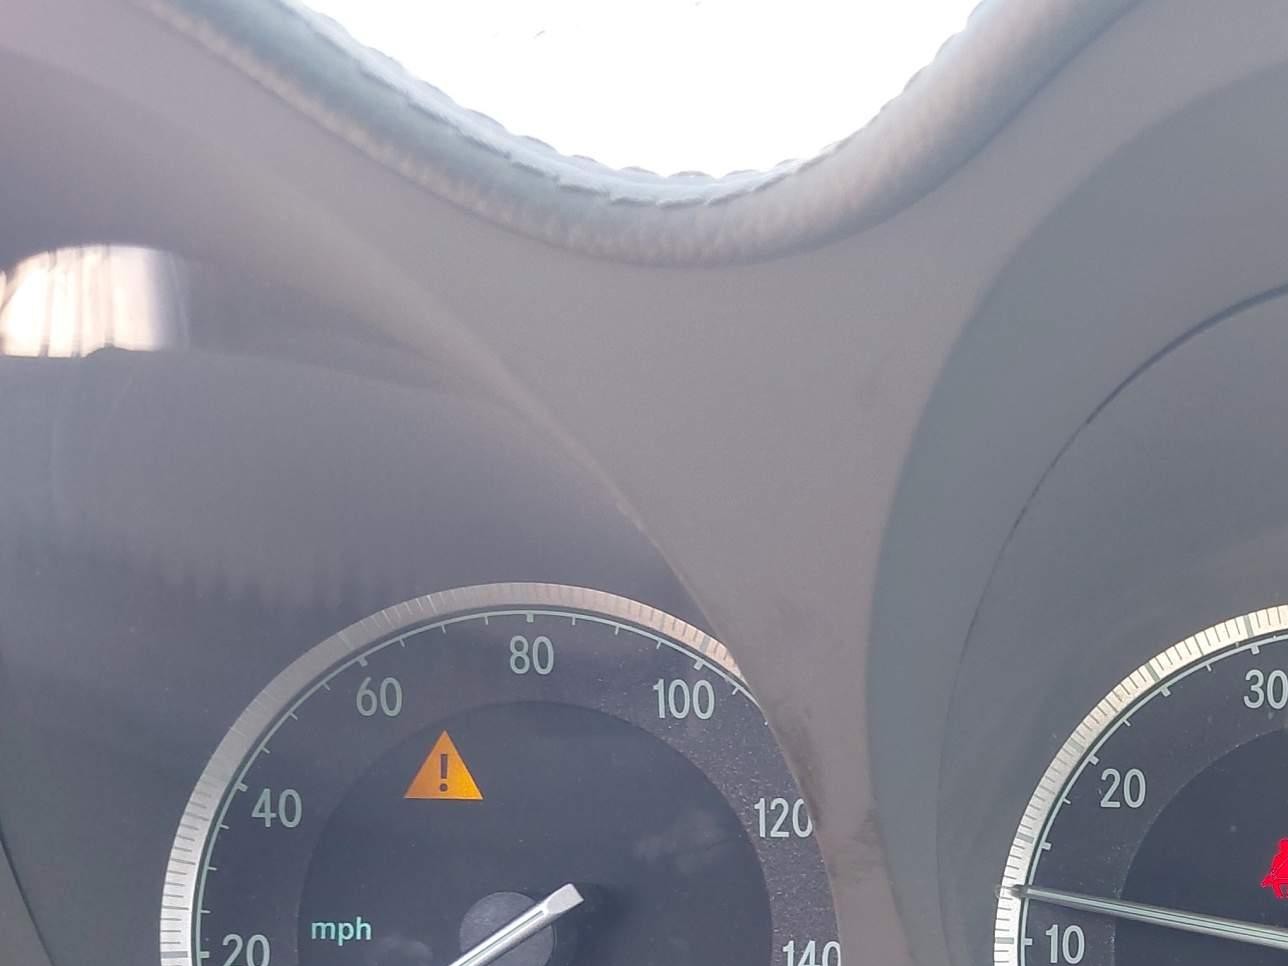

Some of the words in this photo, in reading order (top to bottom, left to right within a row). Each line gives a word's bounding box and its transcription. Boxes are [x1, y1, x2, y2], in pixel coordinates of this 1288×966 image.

[509, 635, 554, 675] 80
[356, 676, 403, 717] 60
[652, 678, 715, 720] 100
[1243, 669, 1288, 710] 30
[251, 788, 302, 828] 40
[1100, 768, 1146, 808] 20
[754, 797, 813, 838] 120
[311, 916, 372, 942] mph
[1045, 924, 1085, 964] 10
